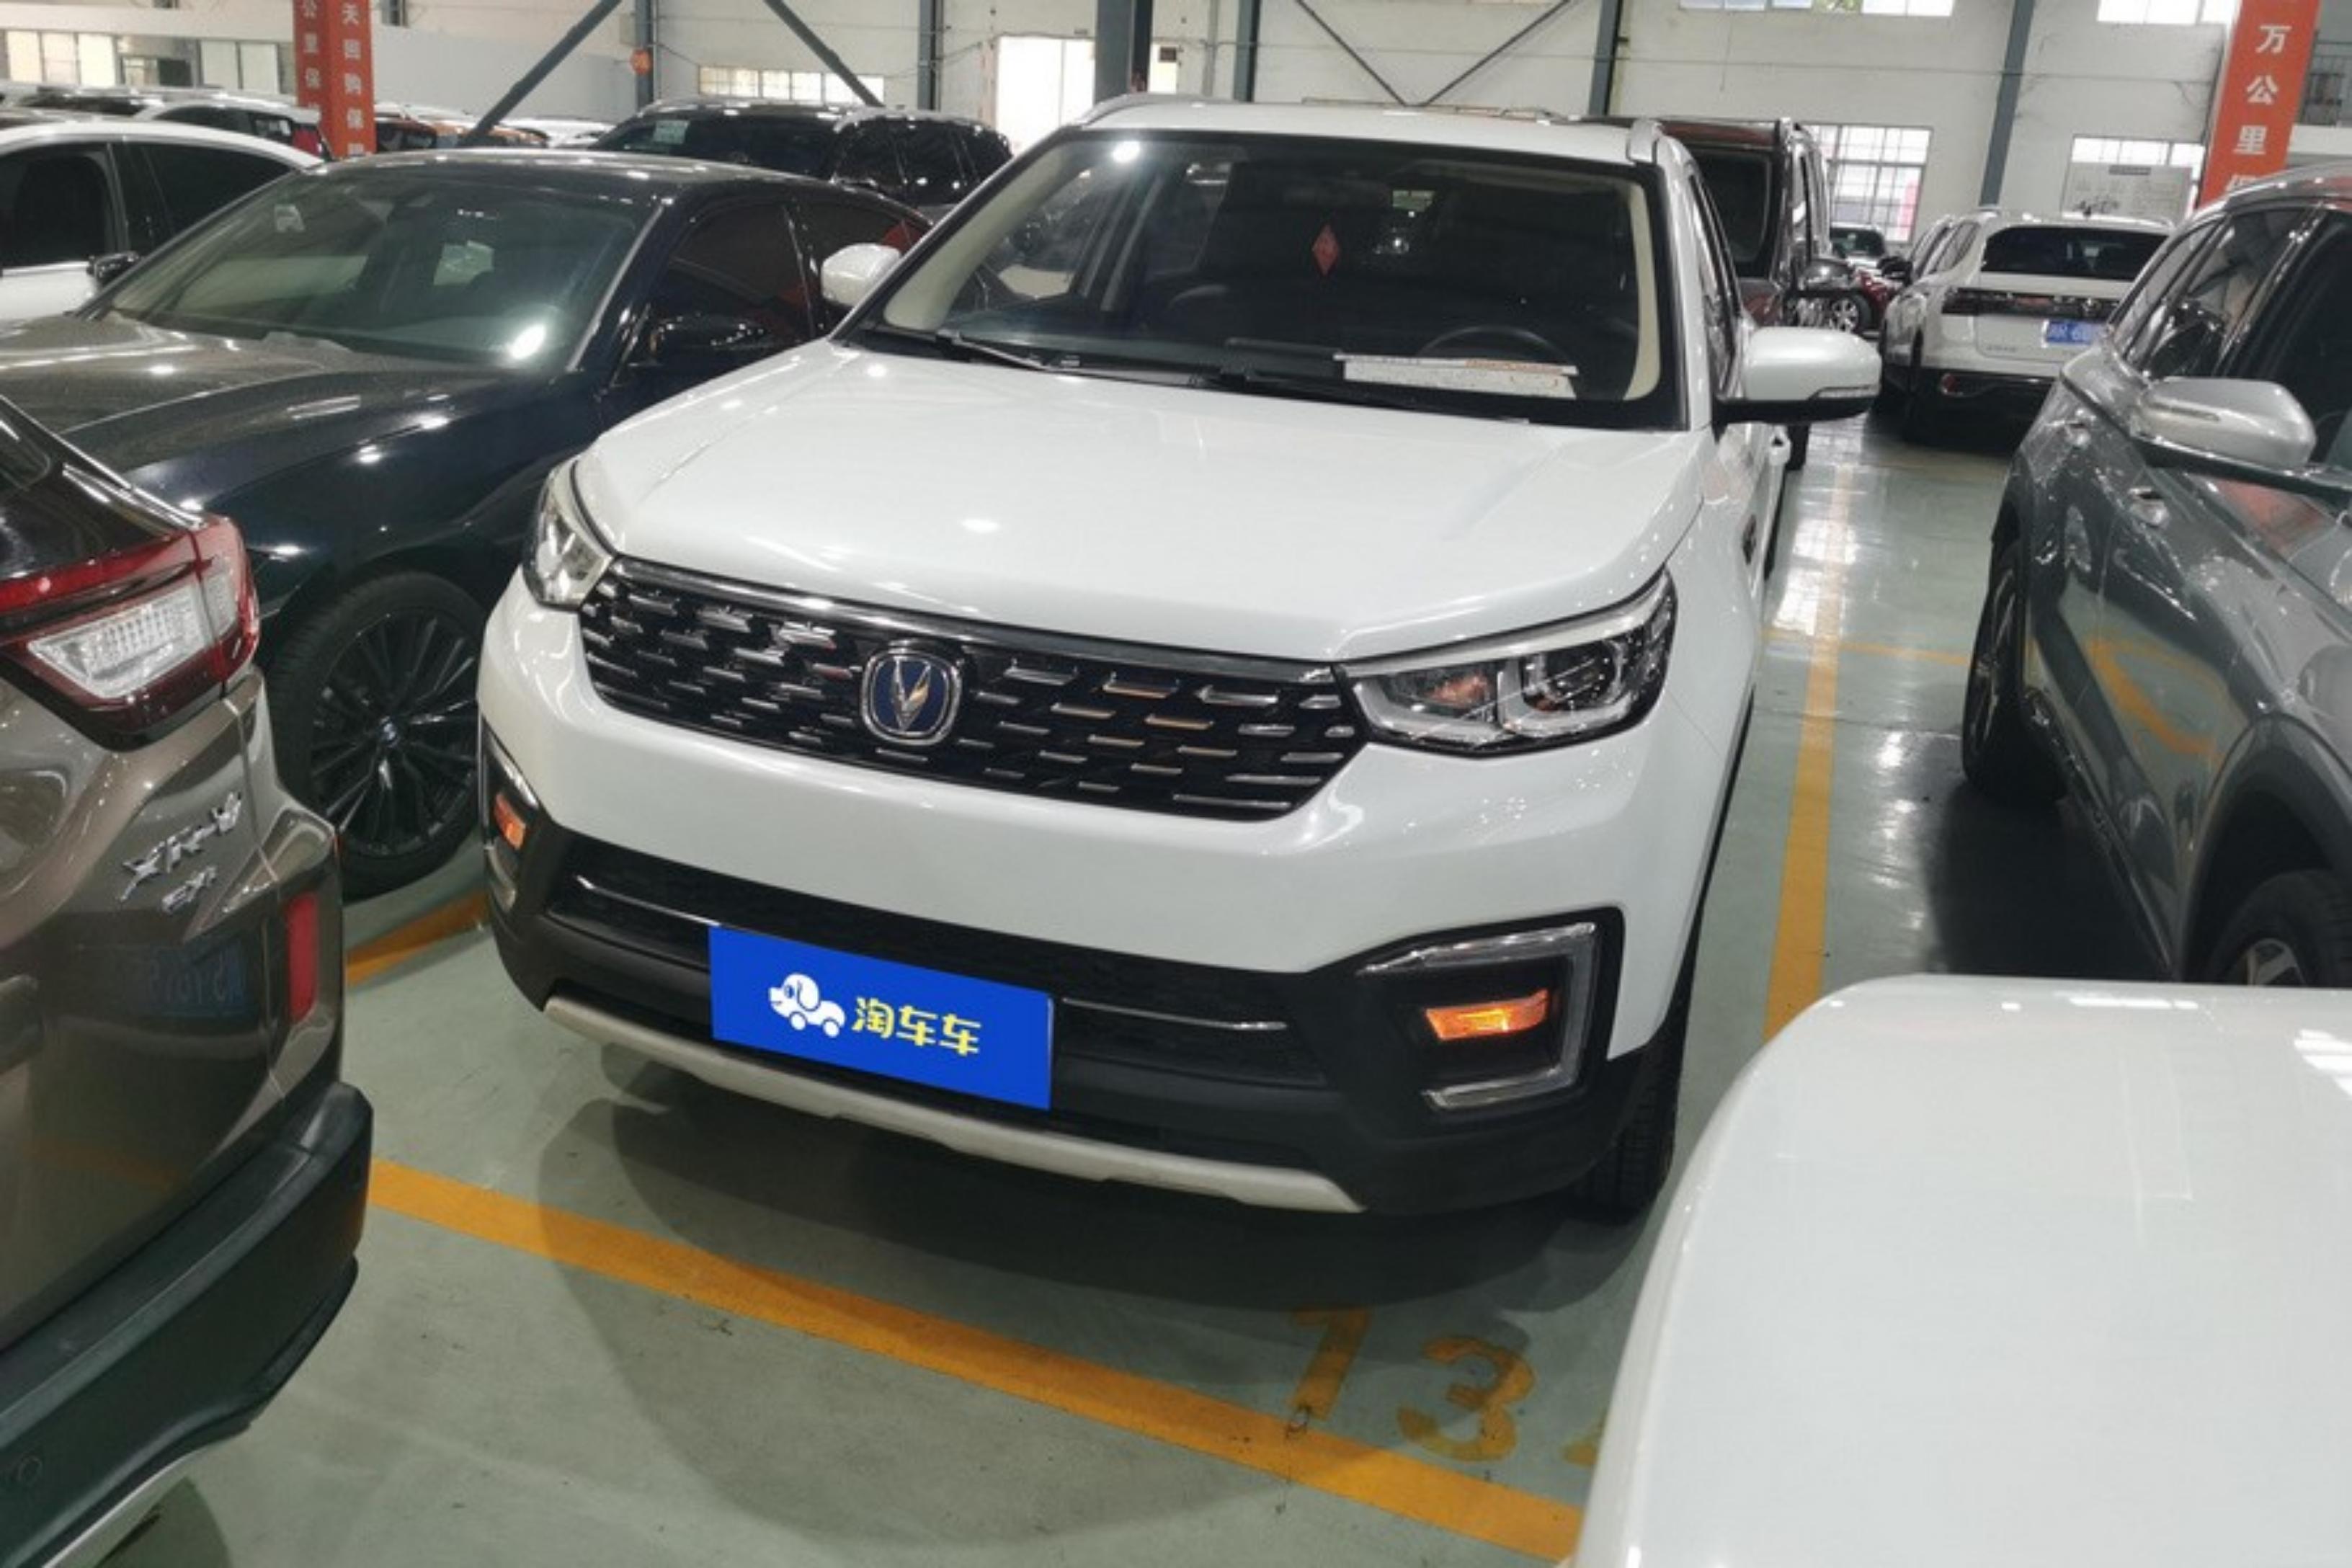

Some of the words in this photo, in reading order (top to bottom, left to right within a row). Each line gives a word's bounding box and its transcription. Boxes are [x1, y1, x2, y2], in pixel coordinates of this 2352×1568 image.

[303, 0, 321, 110] 公里保
[1287, 1306, 1609, 1466] 73
